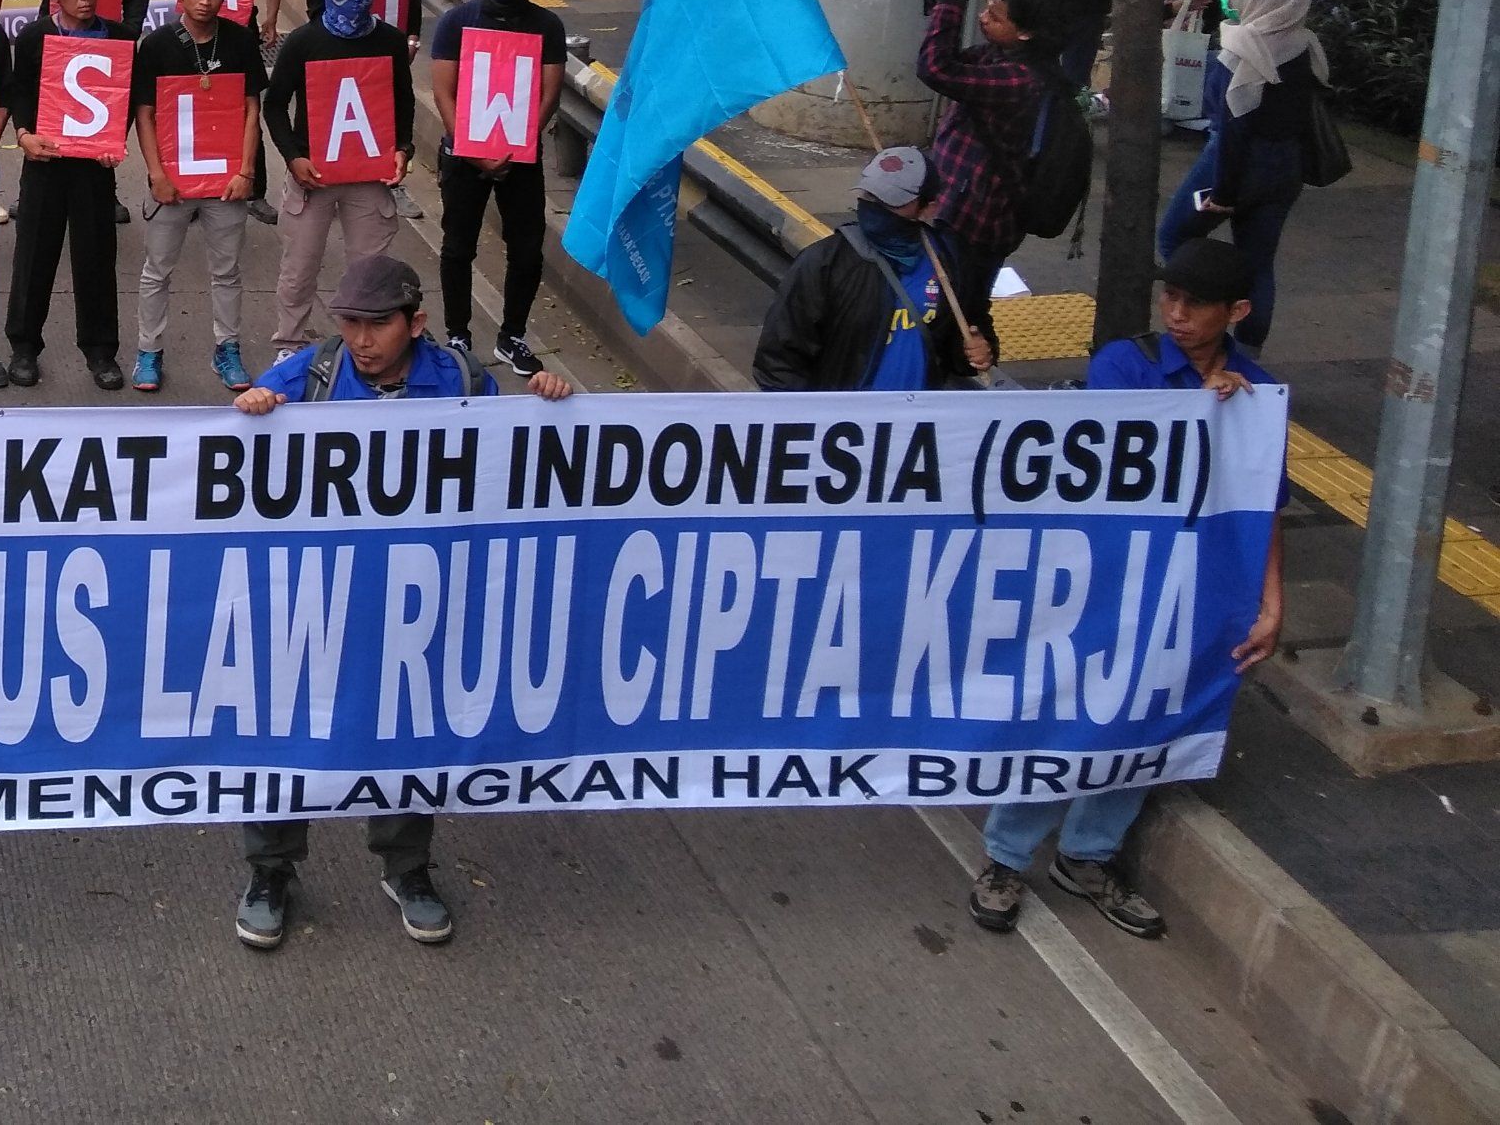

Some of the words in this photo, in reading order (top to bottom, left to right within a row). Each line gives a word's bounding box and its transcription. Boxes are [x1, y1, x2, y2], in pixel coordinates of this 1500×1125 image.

[62, 54, 112, 138] S
[177, 94, 229, 176] L
[325, 76, 381, 163] A
[471, 51, 535, 147] W
[195, 427, 479, 521] BURUH
[505, 421, 943, 510] INDONESIA
[971, 418, 1211, 527] (GSBI)
[140, 545, 356, 740] LAW
[376, 536, 577, 741] RUU
[602, 529, 862, 727] CIPTA
[891, 528, 1199, 727] KERJA
[711, 754, 880, 799] HAK
[908, 747, 1169, 798] BURUH
